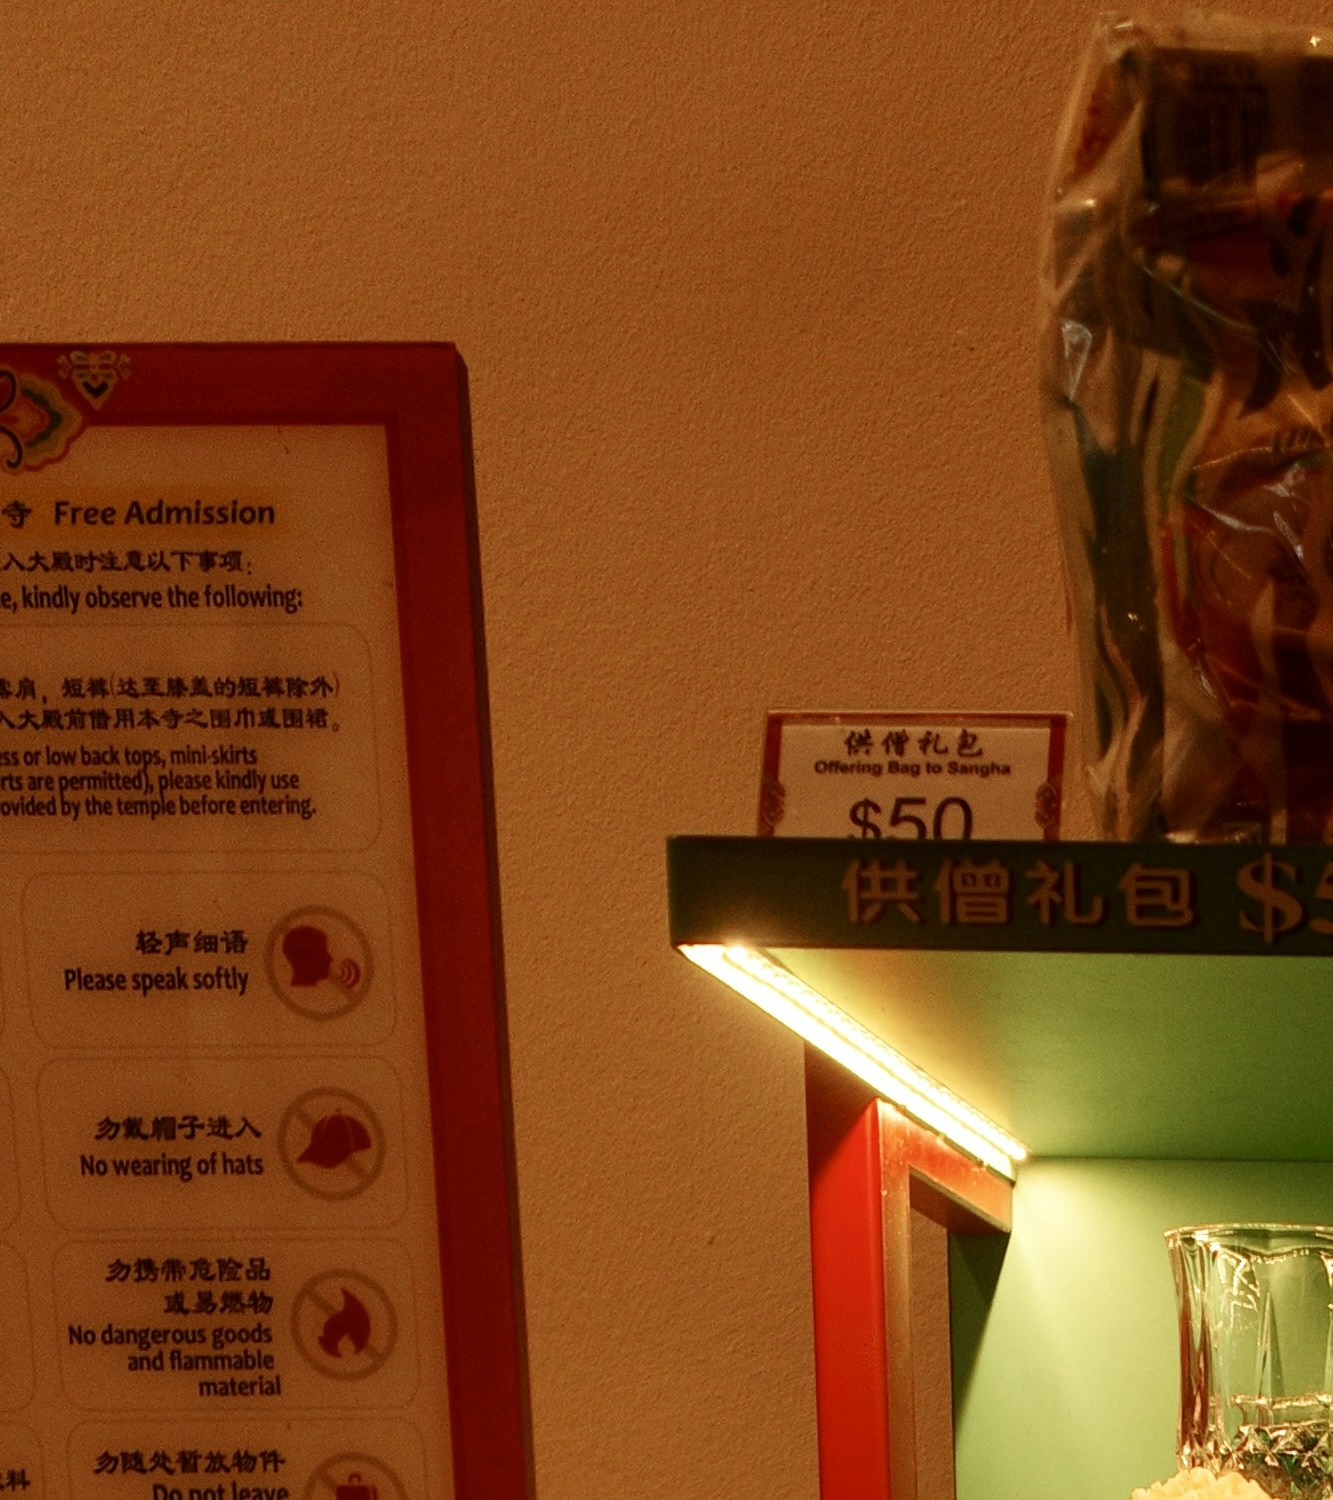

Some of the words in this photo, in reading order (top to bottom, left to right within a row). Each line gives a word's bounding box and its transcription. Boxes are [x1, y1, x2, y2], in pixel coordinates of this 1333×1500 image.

[54, 501, 117, 525] Free
[124, 500, 275, 526] Admission
[22, 583, 80, 614] kindly
[85, 585, 162, 608] observe
[168, 583, 199, 607] the
[204, 583, 303, 614] following:
[24, 750, 42, 767] or
[46, 746, 76, 767] low
[81, 745, 119, 767] back
[171, 745, 257, 767] mini-skirts
[843, 728, 985, 758] 供僧礼包
[814, 759, 883, 778] Offering
[887, 759, 922, 778] Bag
[926, 759, 942, 775] to
[947, 760, 1011, 778] Sangha
[28, 774, 54, 791] are
[159, 770, 211, 799] please
[216, 769, 266, 798] kindly
[271, 774, 299, 791] use
[61, 797, 80, 820] by
[86, 797, 112, 816] the
[117, 798, 175, 820] temple
[179, 797, 235, 817] before
[240, 797, 317, 820] entering.
[849, 796, 974, 840] $50
[841, 855, 1195, 929] 供僧礼包
[135, 928, 249, 956] 轻声细语
[64, 967, 126, 992] Please
[132, 967, 188, 996] speak
[193, 966, 249, 996] softly
[80, 1154, 107, 1177] No
[113, 1155, 192, 1182] wearing
[199, 1153, 217, 1176] of
[221, 1153, 264, 1175] hats
[68, 1325, 96, 1346] No
[101, 1324, 206, 1350] dangerous
[212, 1323, 272, 1348] goods
[128, 1350, 164, 1371] and
[169, 1349, 275, 1371] flammable
[199, 1374, 281, 1397] material
